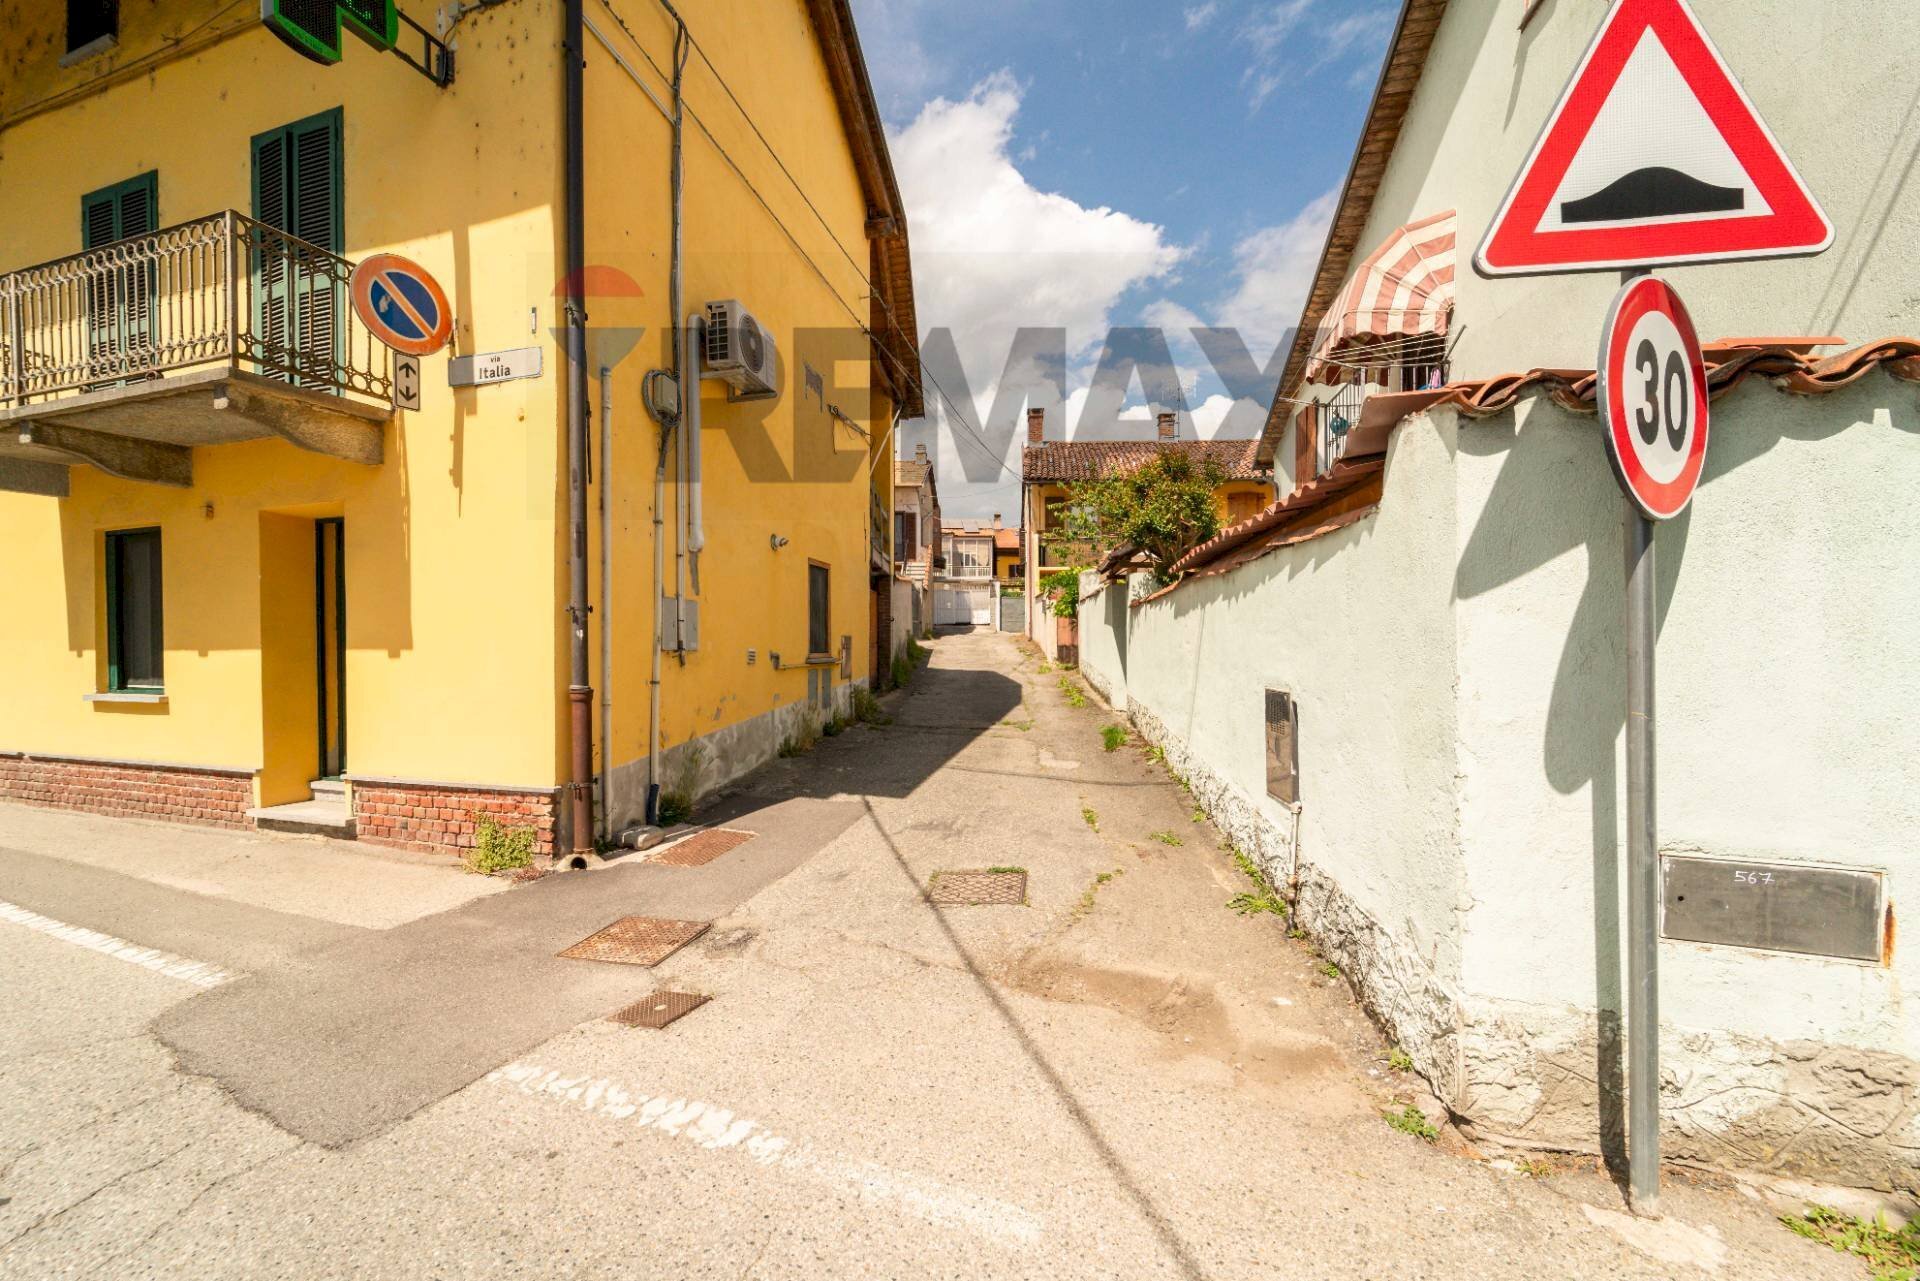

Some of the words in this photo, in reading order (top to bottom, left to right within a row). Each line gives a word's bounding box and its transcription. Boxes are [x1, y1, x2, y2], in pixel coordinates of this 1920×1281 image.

[490, 355, 501, 363] via
[479, 365, 511, 380] Italia
[1635, 338, 1689, 452] 30
[1734, 870, 1776, 885] 567
